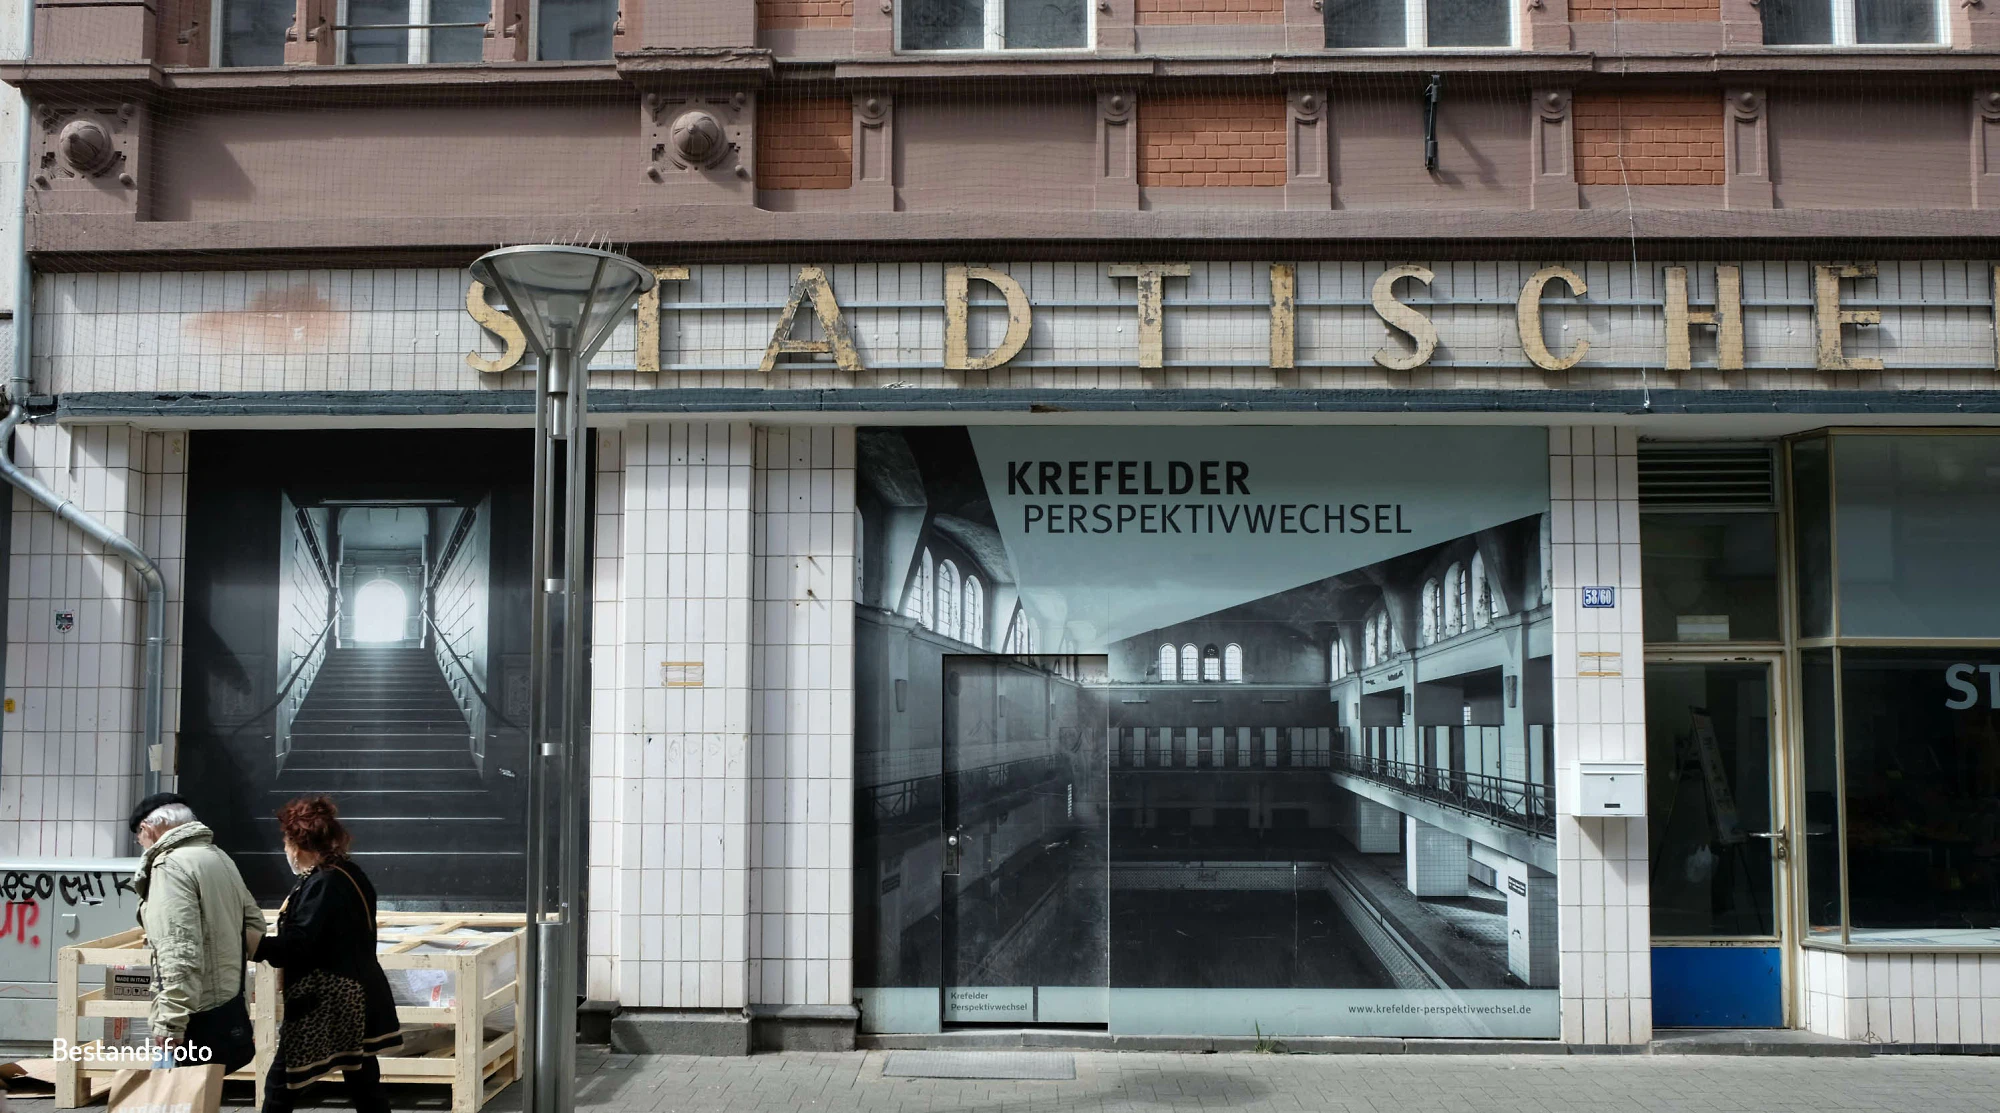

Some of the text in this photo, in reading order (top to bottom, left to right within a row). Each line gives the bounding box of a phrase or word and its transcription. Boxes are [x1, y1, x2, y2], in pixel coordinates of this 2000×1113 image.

[1007, 460, 1251, 496] KREFELDER
[1024, 503, 1412, 534] PERSPEKTIVWECHSEL
[1585, 589, 1612, 605] 58/60
[950, 992, 989, 1000] Krefelder
[950, 1003, 1028, 1012] Perspektivwechsel
[1348, 1004, 1532, 1015] www.krefelder-perspektivwechsel.de
